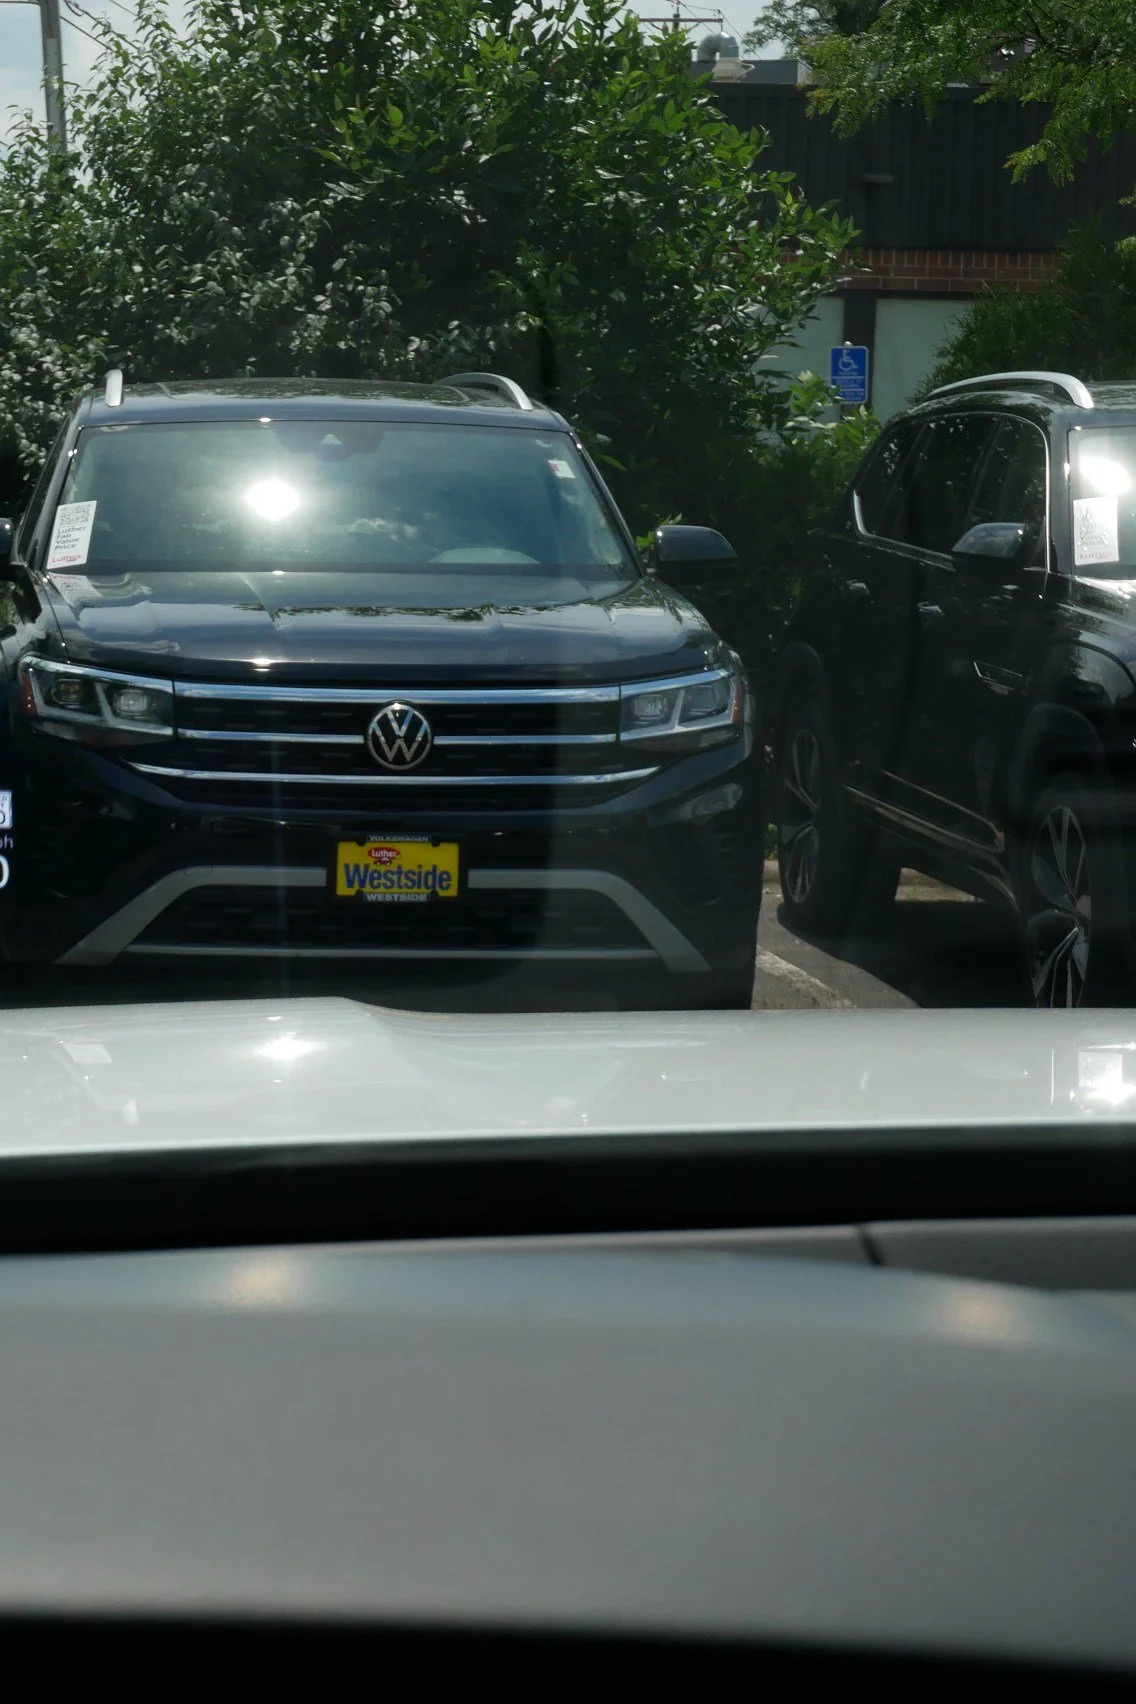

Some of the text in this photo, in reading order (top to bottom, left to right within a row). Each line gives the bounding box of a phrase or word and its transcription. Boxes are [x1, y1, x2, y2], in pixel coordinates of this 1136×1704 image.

[371, 849, 399, 859] Luther
[343, 862, 452, 892] Westside
[366, 892, 429, 902] WESTSIDE
